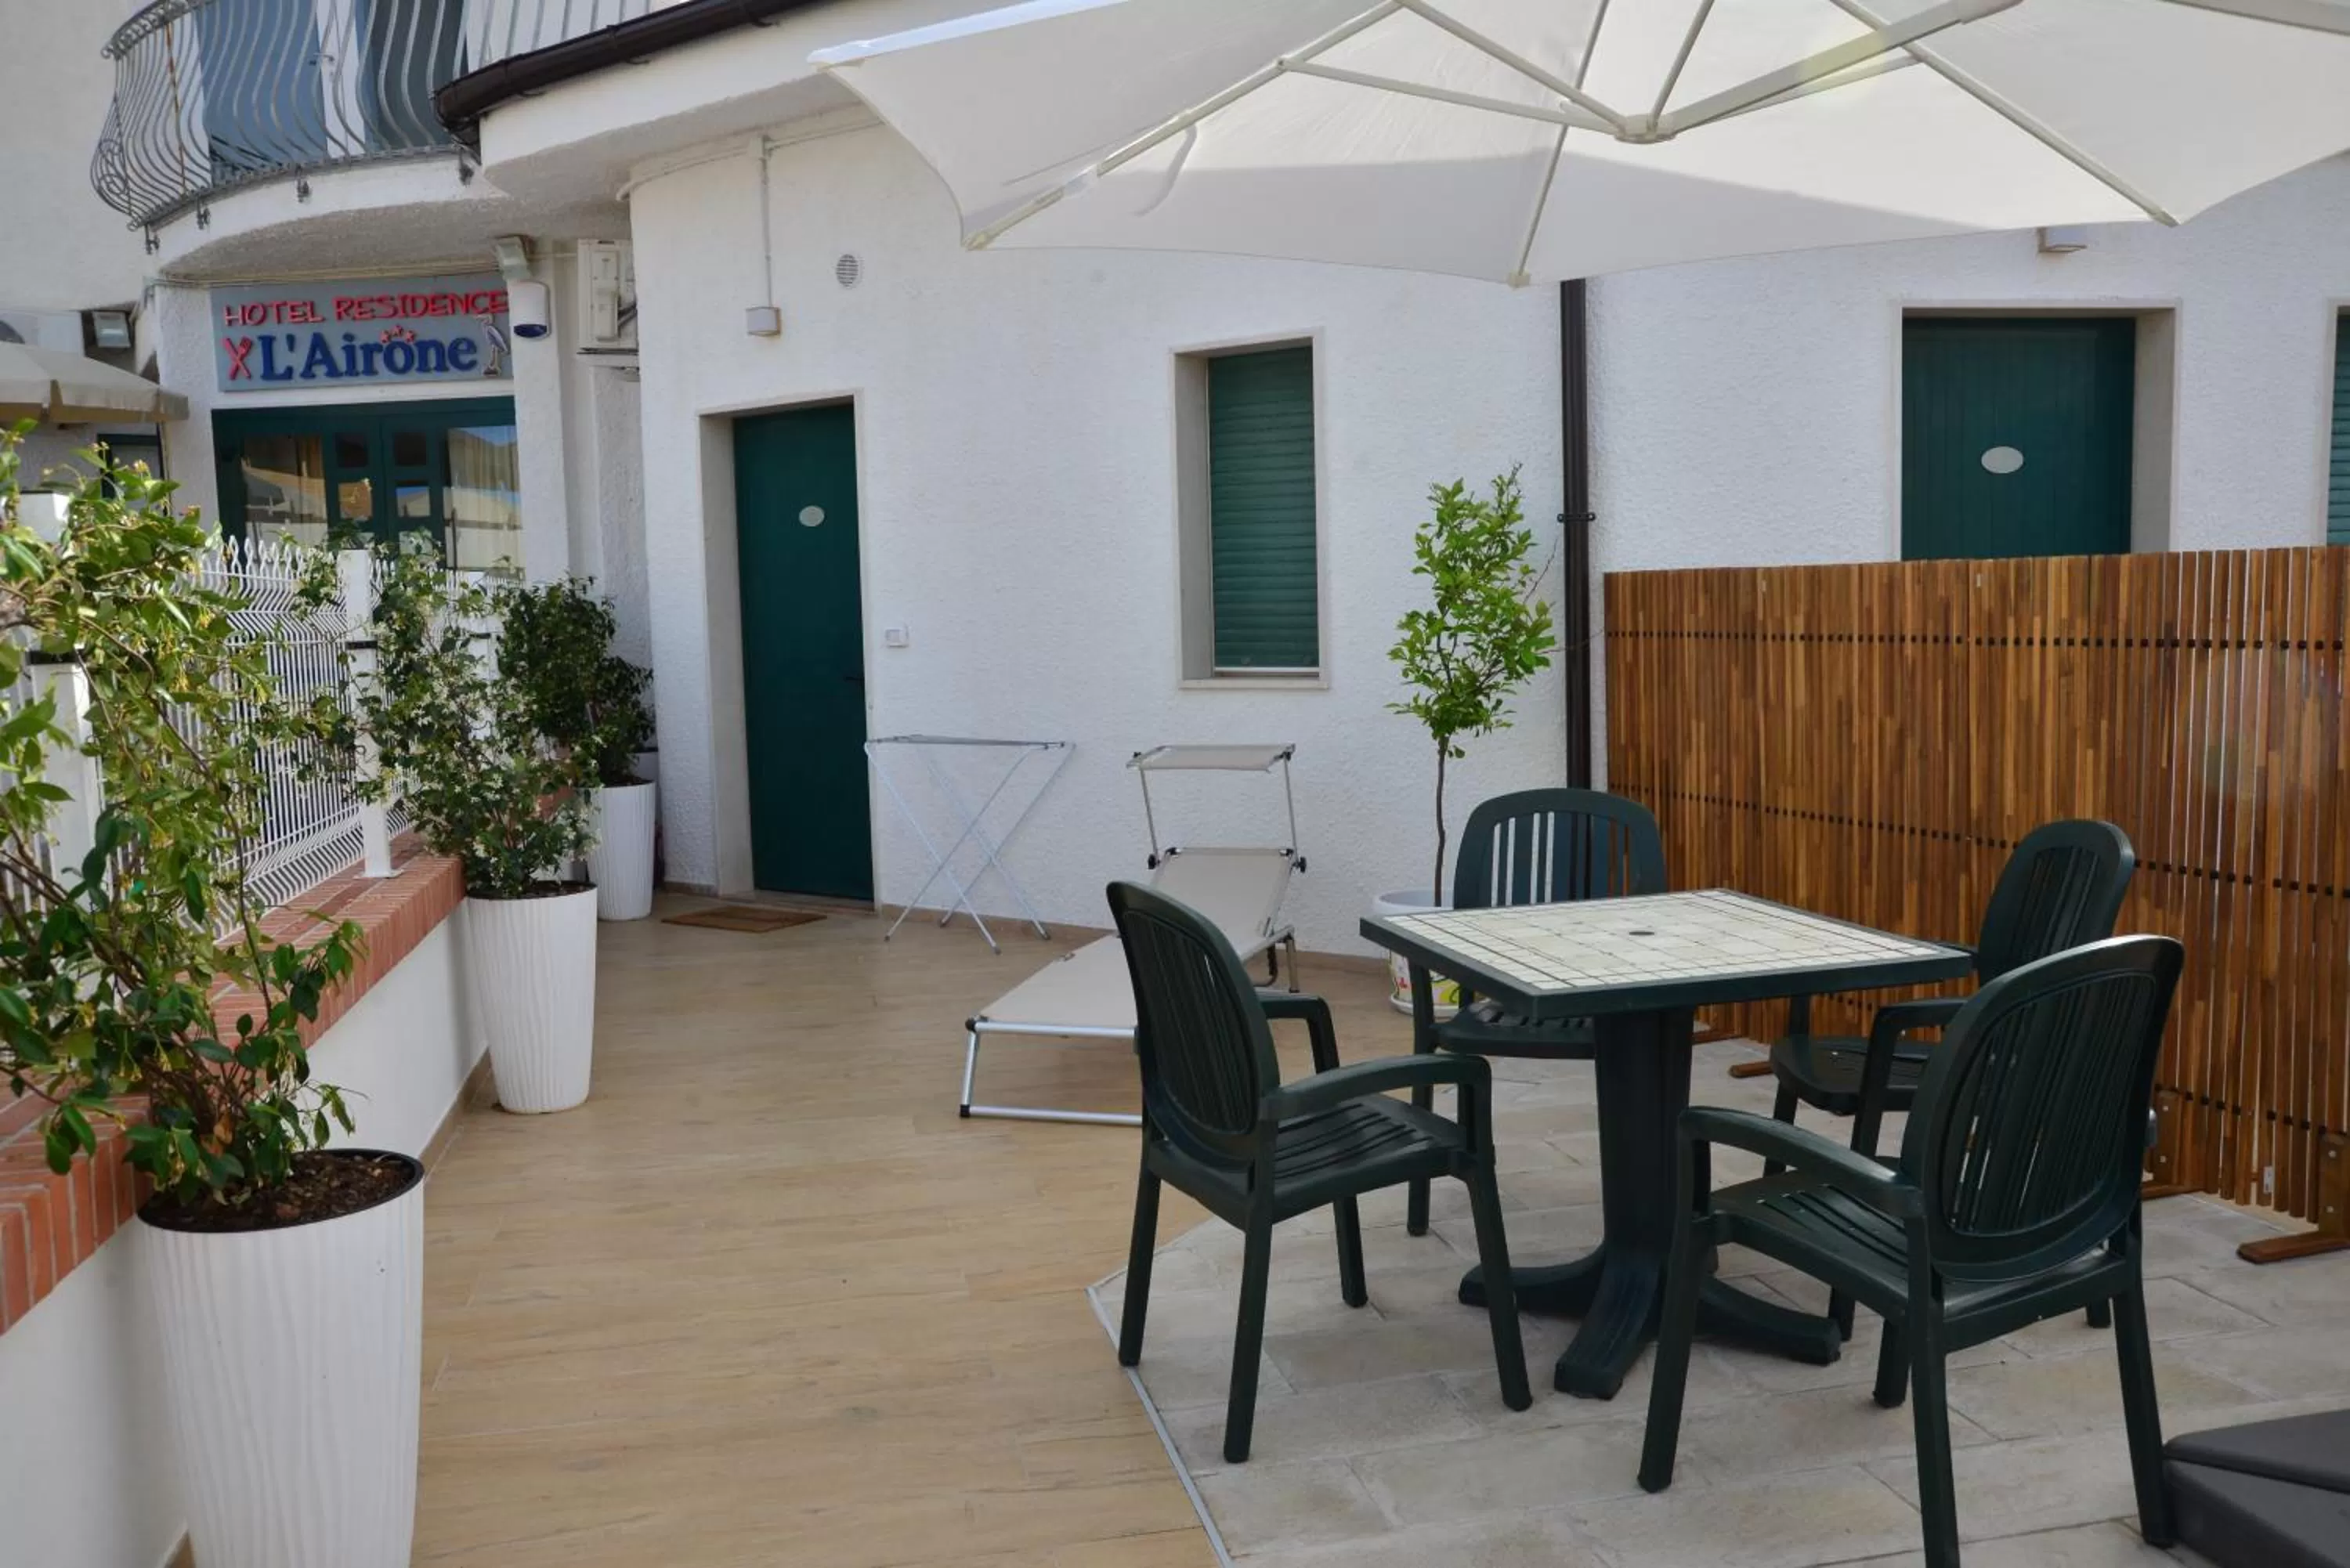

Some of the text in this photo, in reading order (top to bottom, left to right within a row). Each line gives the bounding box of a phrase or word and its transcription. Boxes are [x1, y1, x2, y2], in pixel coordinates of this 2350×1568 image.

[225, 290, 509, 327] HOTEL RESIDENCE
[258, 331, 478, 381] L'Airone
